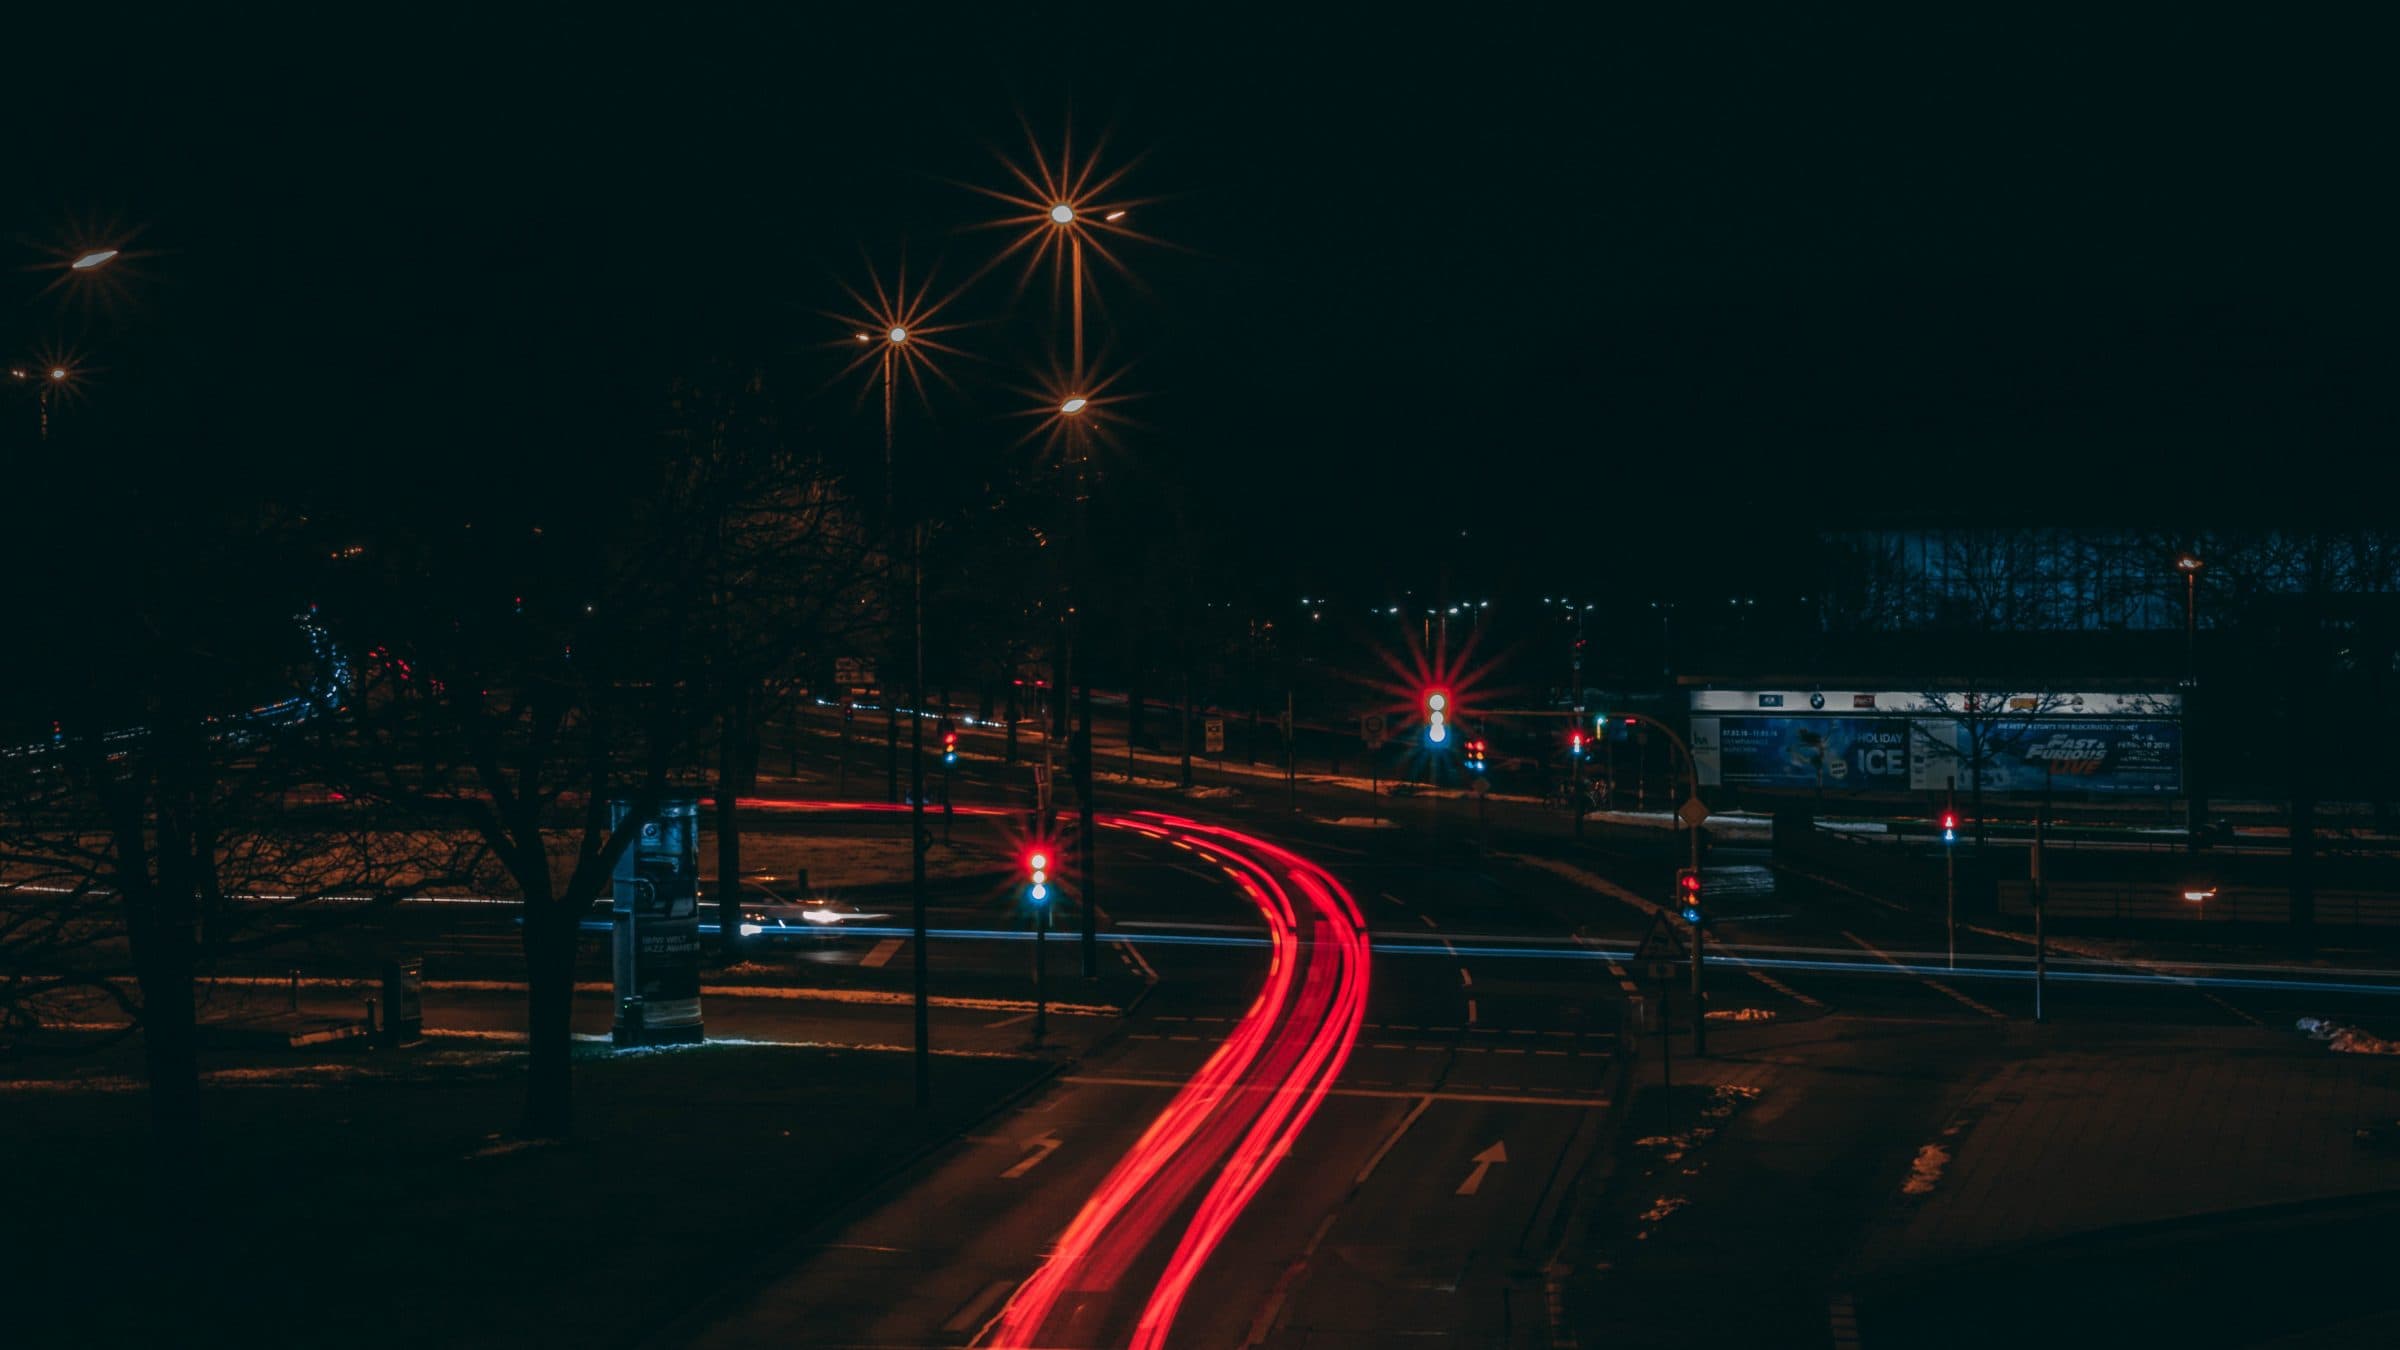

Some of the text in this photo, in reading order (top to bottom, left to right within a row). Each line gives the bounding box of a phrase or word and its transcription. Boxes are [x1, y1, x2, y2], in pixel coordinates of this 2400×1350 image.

[1857, 733, 1904, 743] HOLIDAY
[2047, 734, 2098, 749] FAST
[2025, 744, 2108, 760] FURIOUS
[1857, 749, 1905, 774] ICE
[2048, 759, 2102, 775] LIVE
